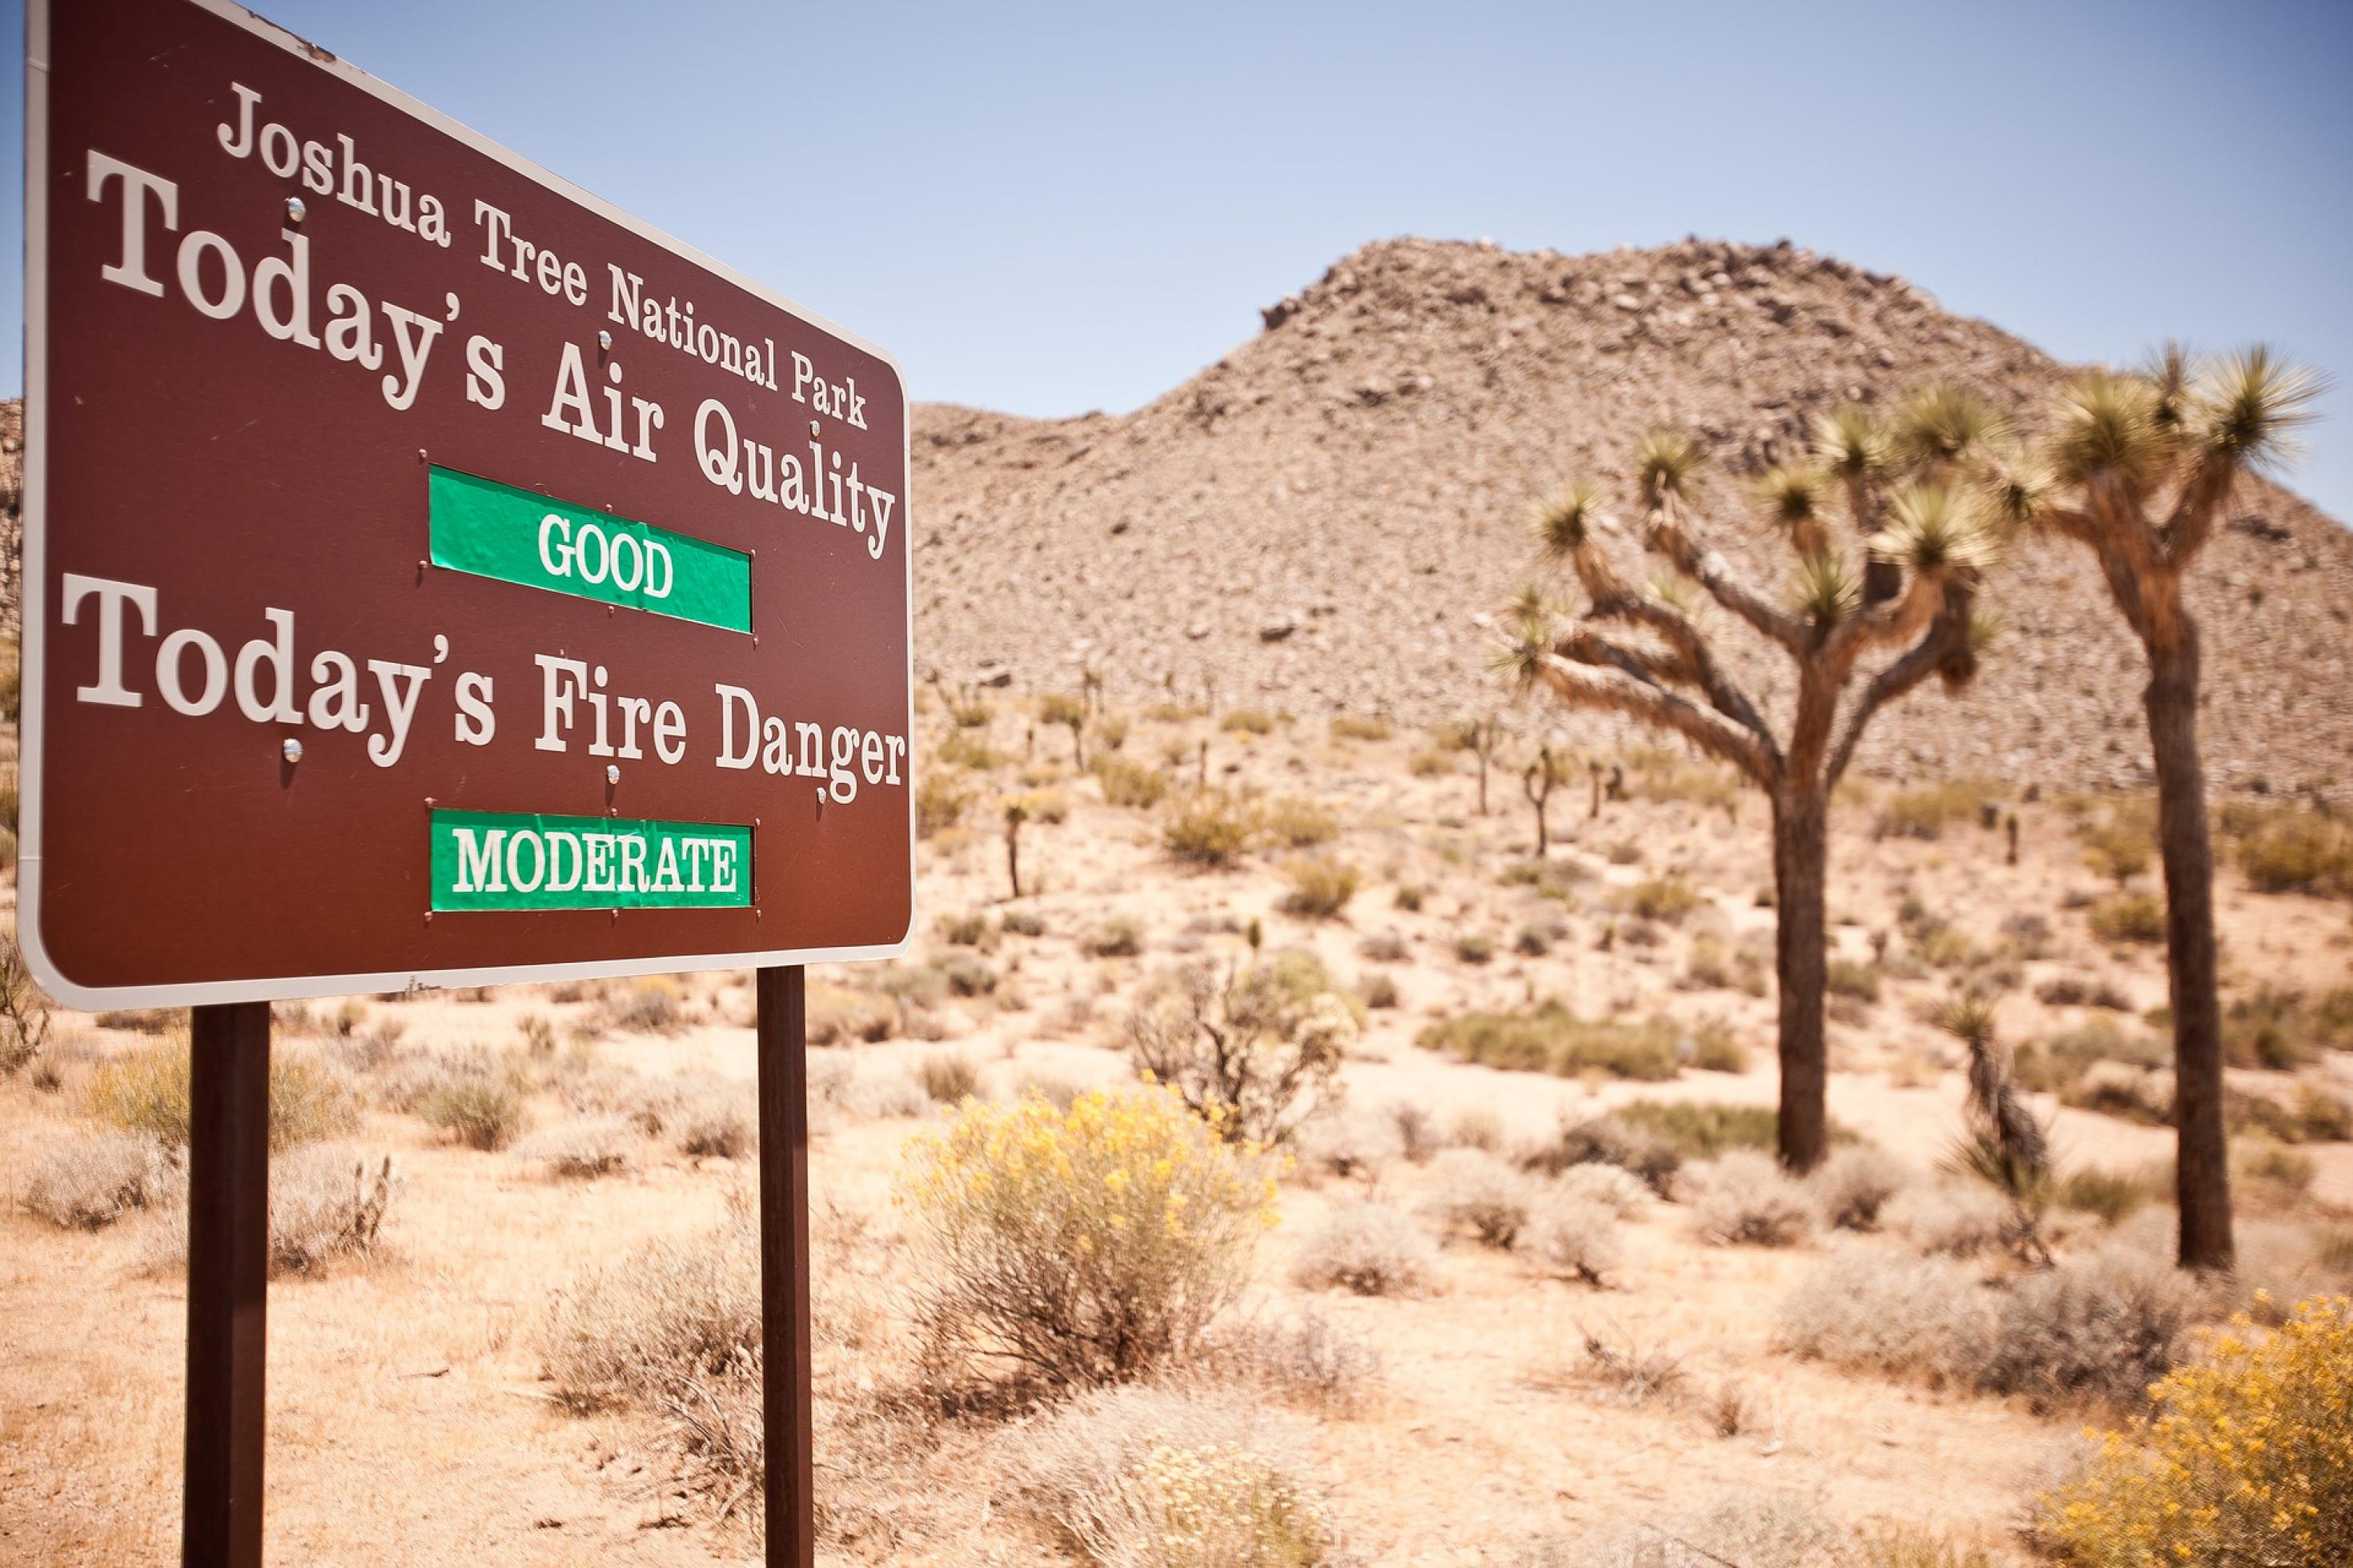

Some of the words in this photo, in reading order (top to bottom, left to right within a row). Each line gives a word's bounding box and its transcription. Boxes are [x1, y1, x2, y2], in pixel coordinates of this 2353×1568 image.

[87, 150, 505, 411] Today's
[541, 341, 665, 463] Air
[693, 399, 896, 559] Quality
[218, 82, 452, 247] Joshua
[475, 199, 588, 306] Tree
[607, 263, 778, 391] National
[791, 350, 868, 431] Park
[538, 514, 674, 599] GOOD
[62, 572, 496, 768] Today's
[534, 653, 687, 765] Fire
[715, 683, 905, 804] Danger
[452, 829, 737, 892] MODERATE
